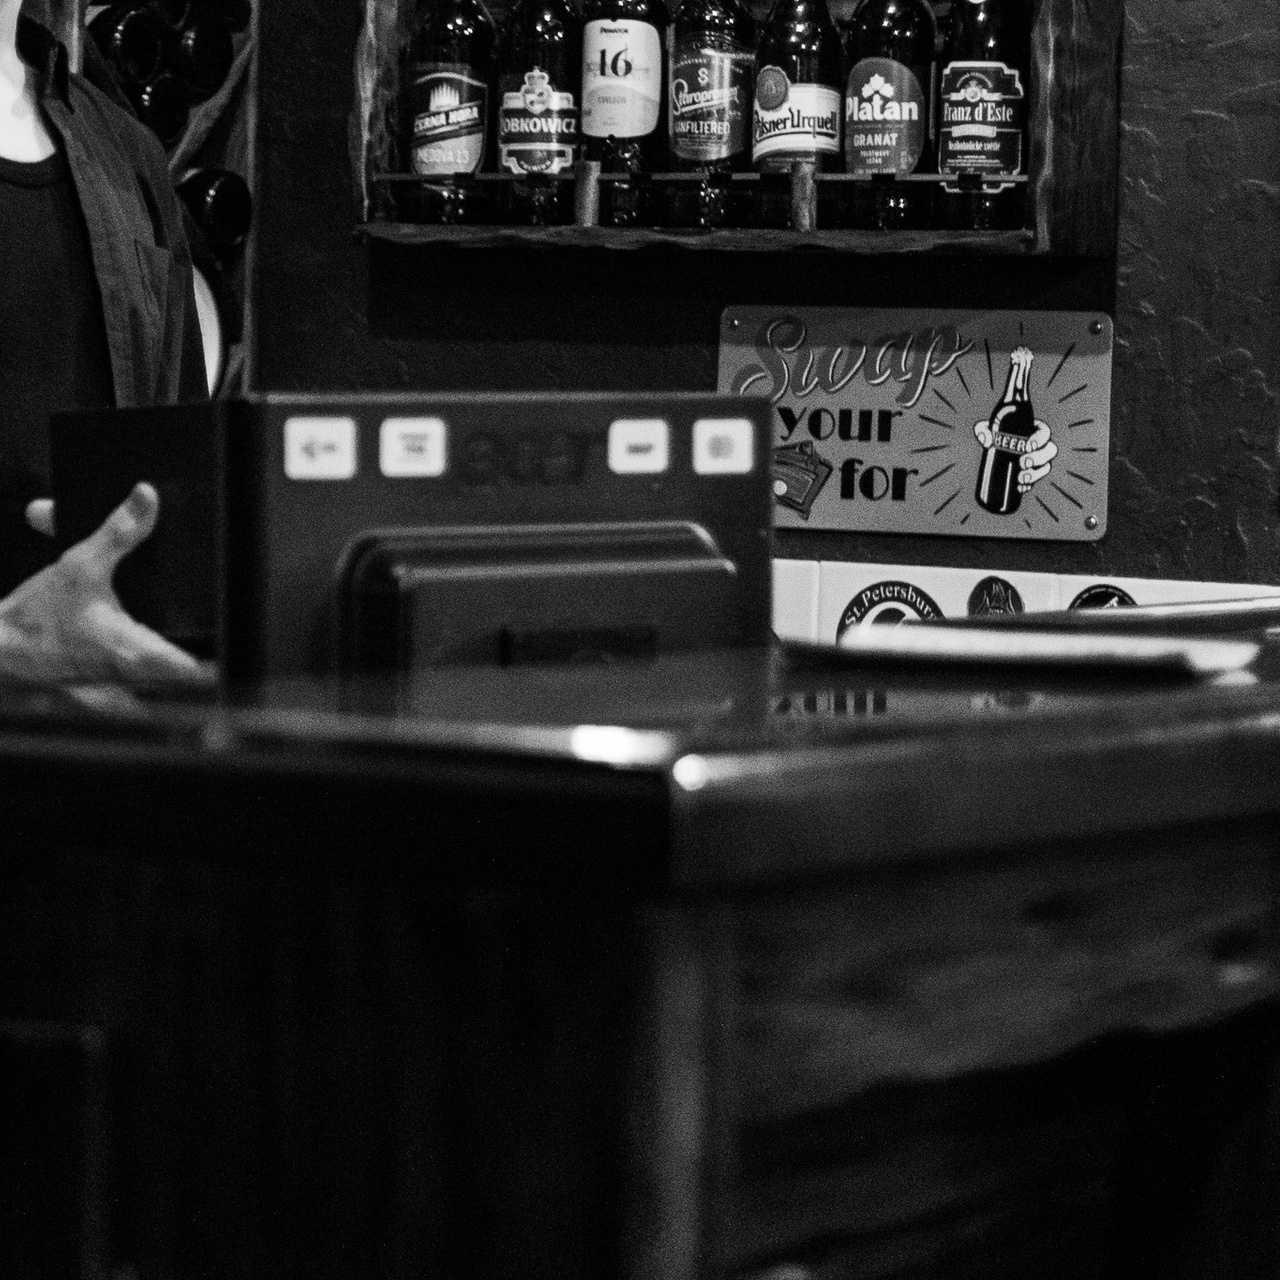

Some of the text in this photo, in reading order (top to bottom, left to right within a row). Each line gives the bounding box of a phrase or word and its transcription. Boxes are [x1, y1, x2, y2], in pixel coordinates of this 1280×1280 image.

[600, 45, 633, 77] 16
[789, 106, 837, 138] Urquell
[846, 94, 918, 121] Platan
[944, 102, 1013, 122] Franz d'Este
[732, 314, 975, 410] Swap
[778, 406, 903, 442] your
[994, 432, 1026, 452] BEER
[839, 458, 919, 502] for
